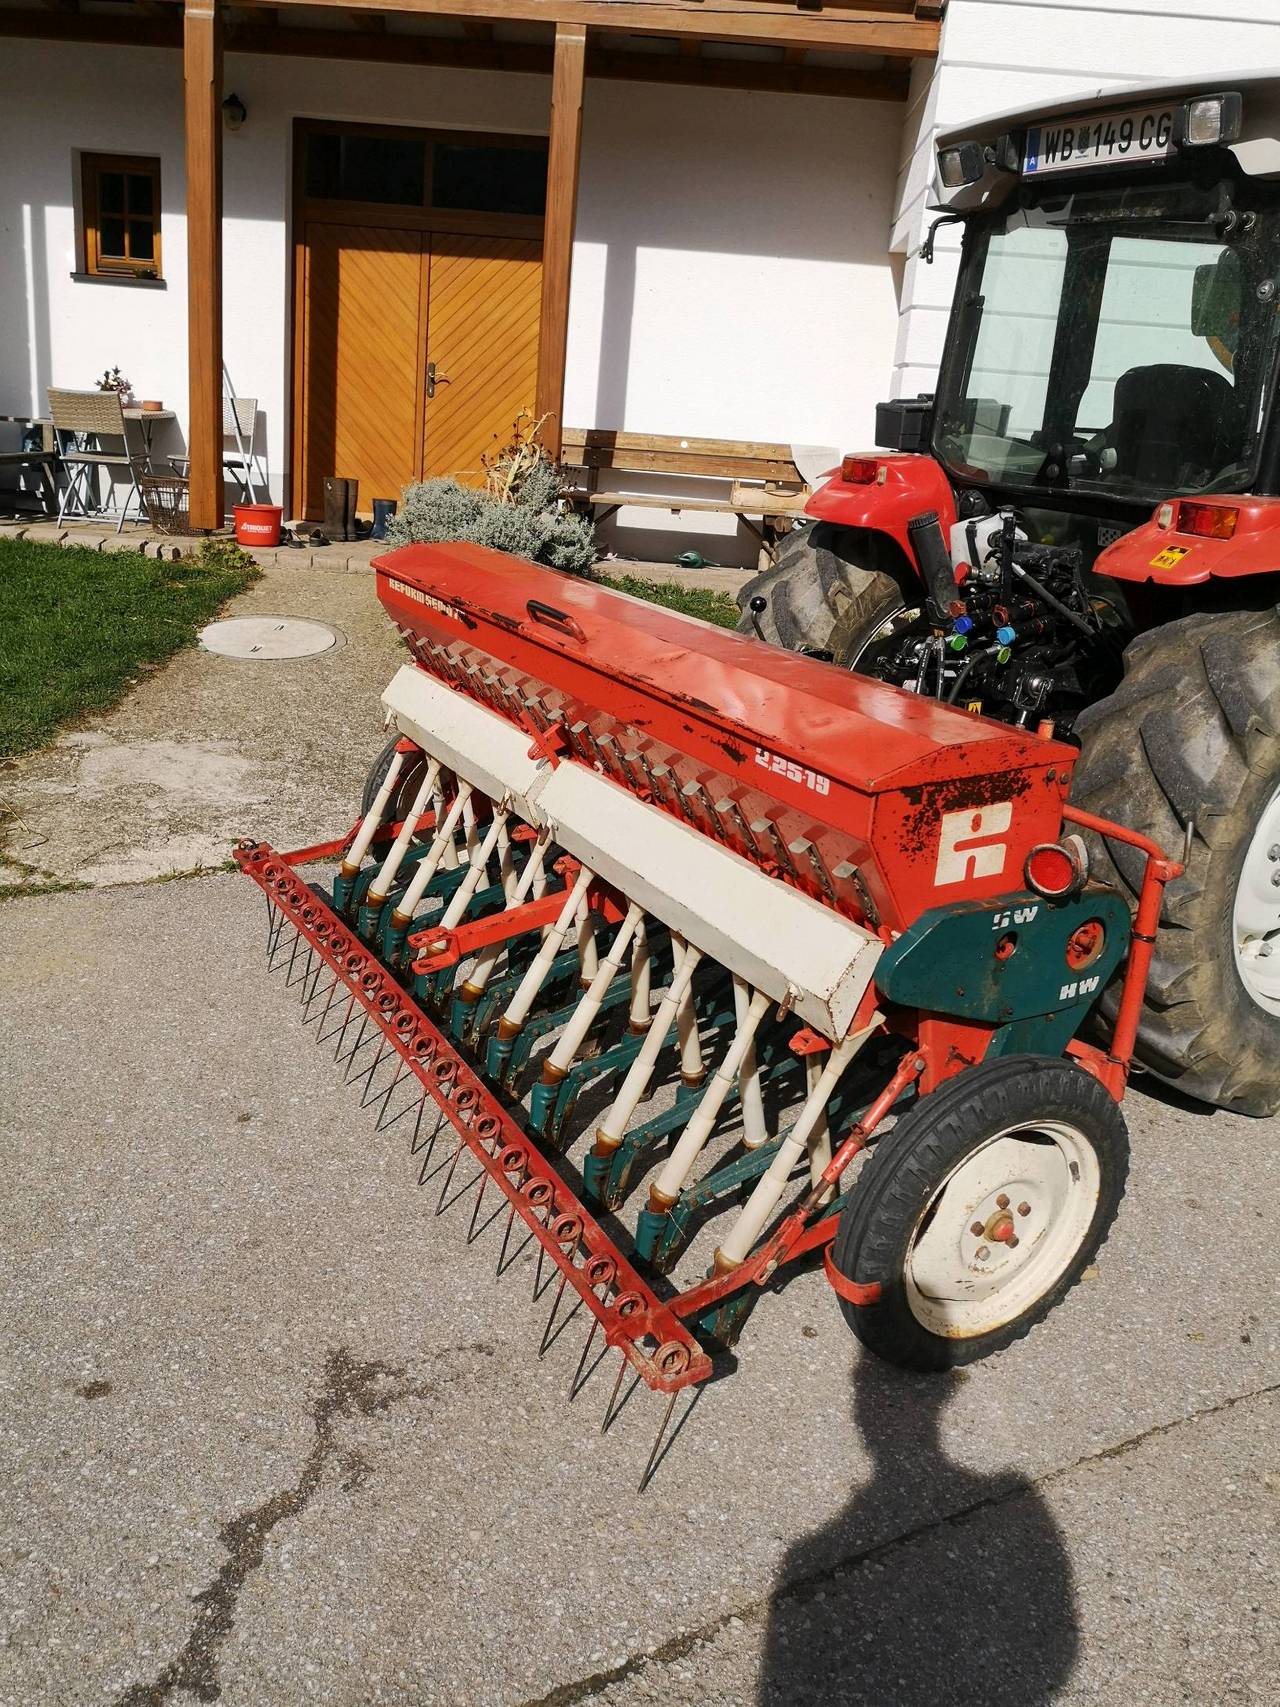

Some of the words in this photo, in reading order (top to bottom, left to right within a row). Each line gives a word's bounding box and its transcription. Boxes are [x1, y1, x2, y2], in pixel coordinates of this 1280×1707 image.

[1045, 128, 1074, 164] WB
[1093, 118, 1134, 157] 149
[1139, 113, 1172, 151] CG
[1029, 157, 1036, 166] A
[389, 577, 425, 605] REFORM
[1059, 976, 1100, 1001] HW
